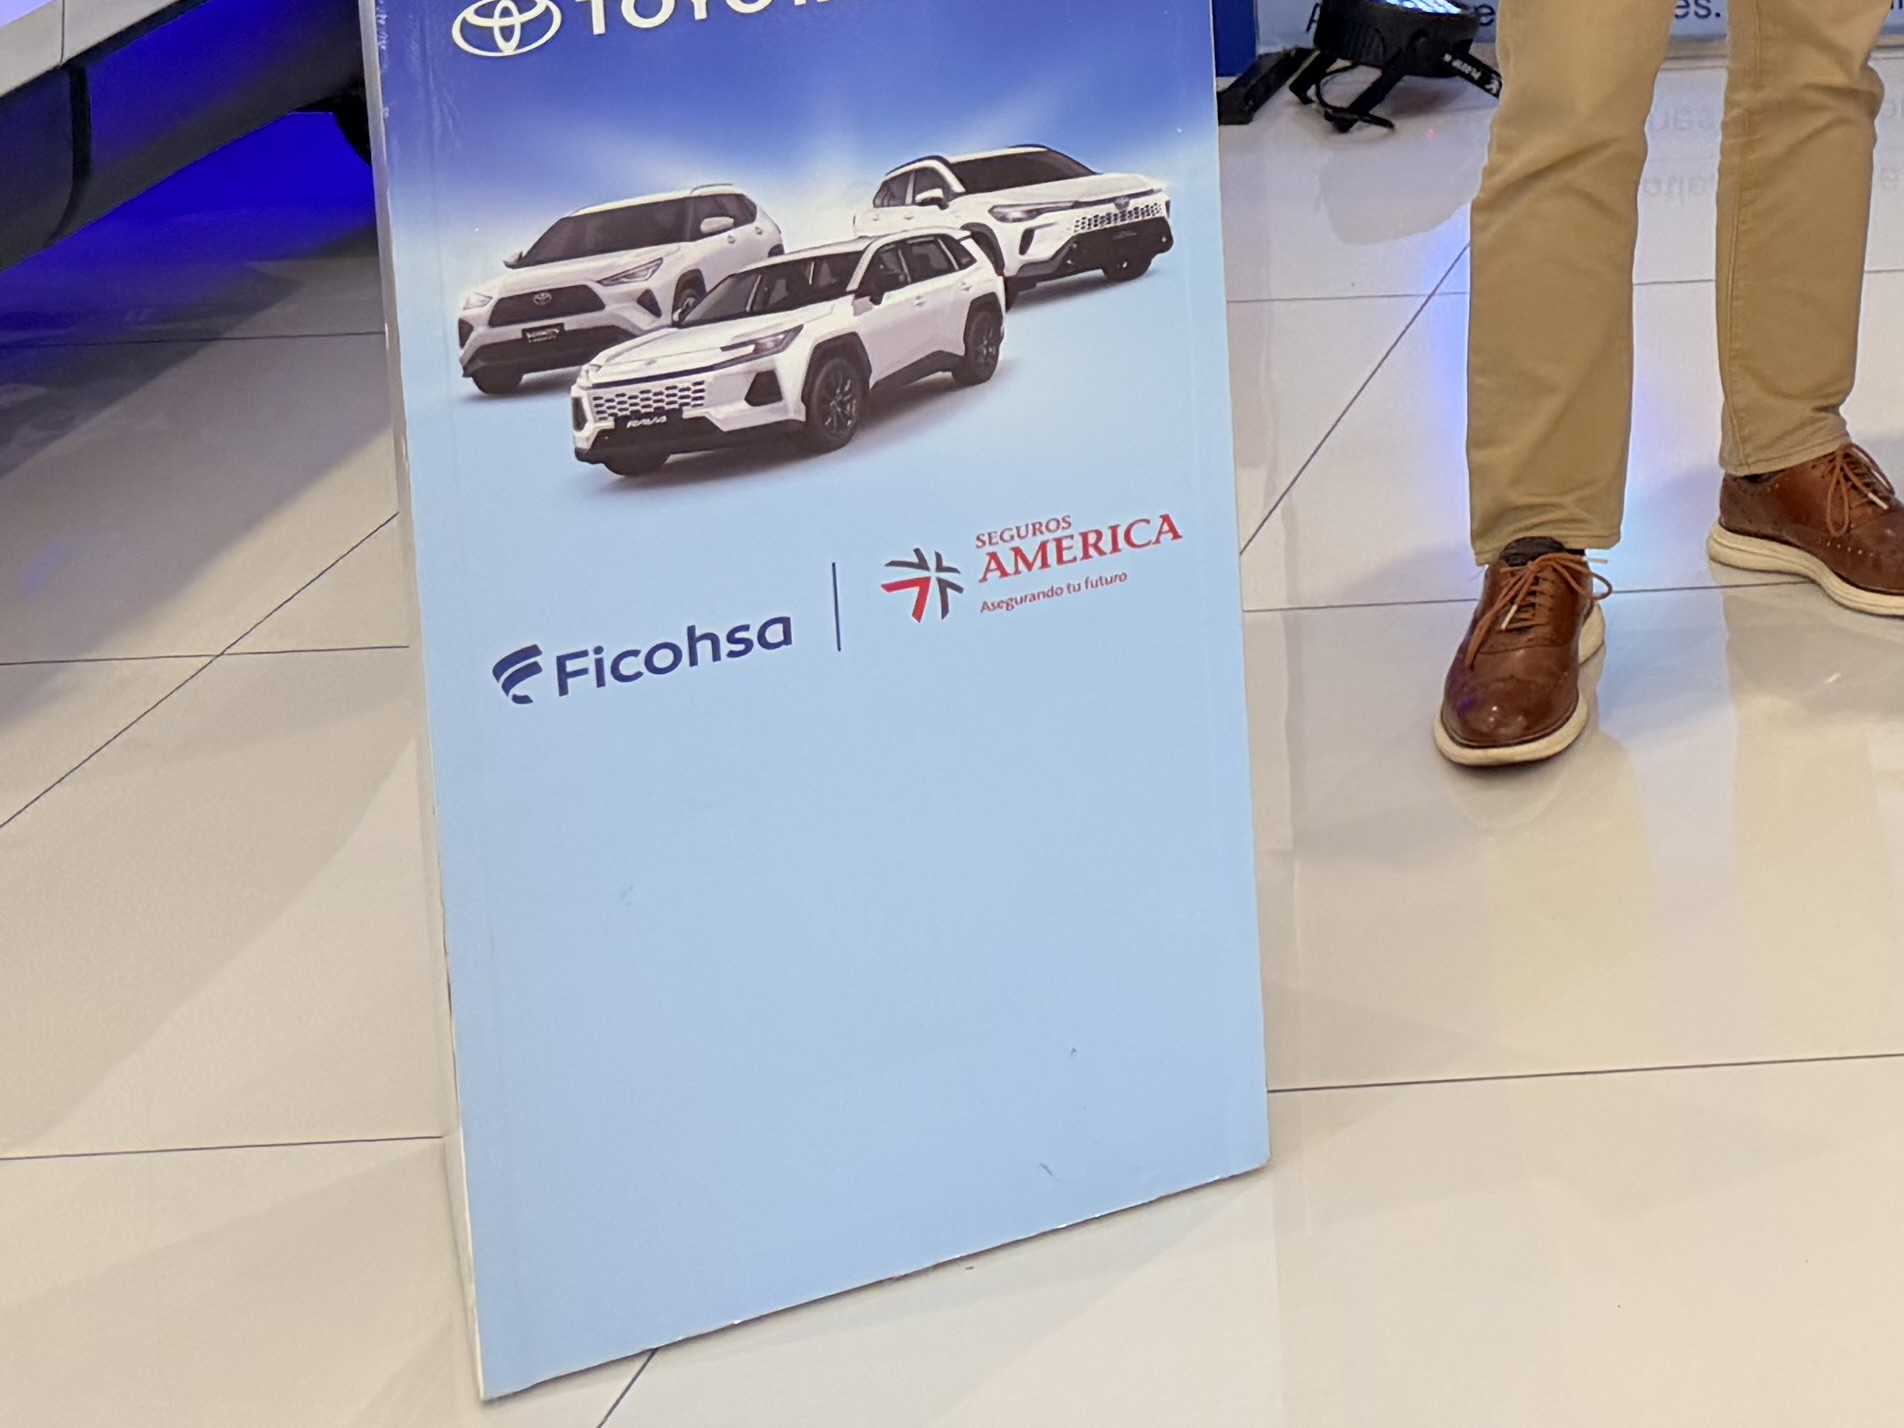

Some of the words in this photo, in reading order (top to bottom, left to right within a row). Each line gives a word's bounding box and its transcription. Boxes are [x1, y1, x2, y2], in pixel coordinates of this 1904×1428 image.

[975, 514, 1073, 549] SEGUROS
[978, 513, 1184, 584] AMERICA
[979, 584, 1065, 614] Asegurando
[1065, 581, 1082, 595] tu
[1084, 570, 1128, 592] futuro
[555, 613, 794, 697] Ficohsa
